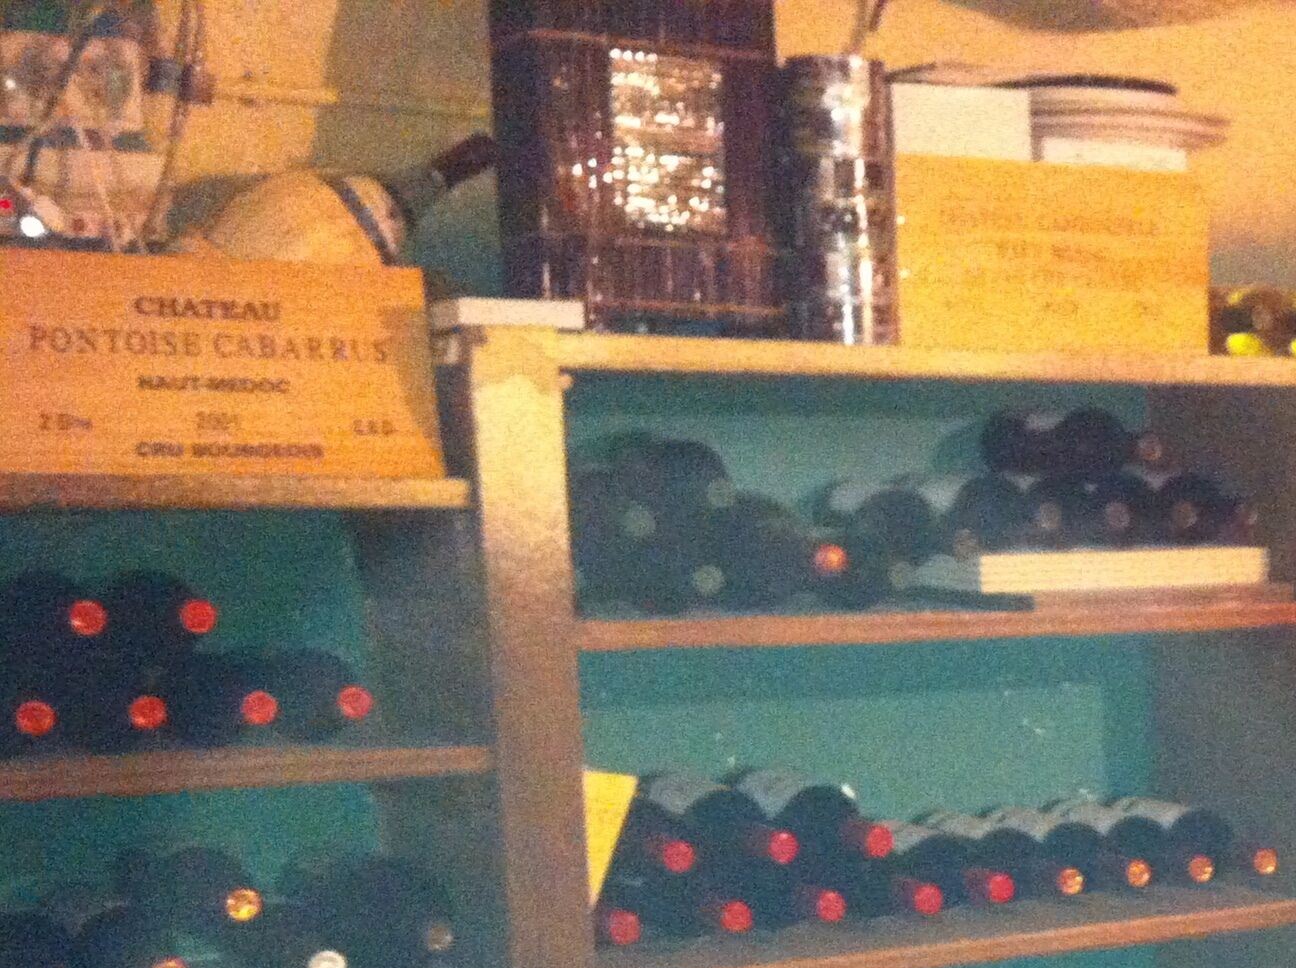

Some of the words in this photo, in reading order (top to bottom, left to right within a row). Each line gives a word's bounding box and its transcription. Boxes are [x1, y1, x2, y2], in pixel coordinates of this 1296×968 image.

[133, 295, 282, 322] CHATEAU
[28, 324, 203, 358] PONTOISE
[211, 333, 392, 365] CABARRUS
[135, 441, 185, 458] CRU
